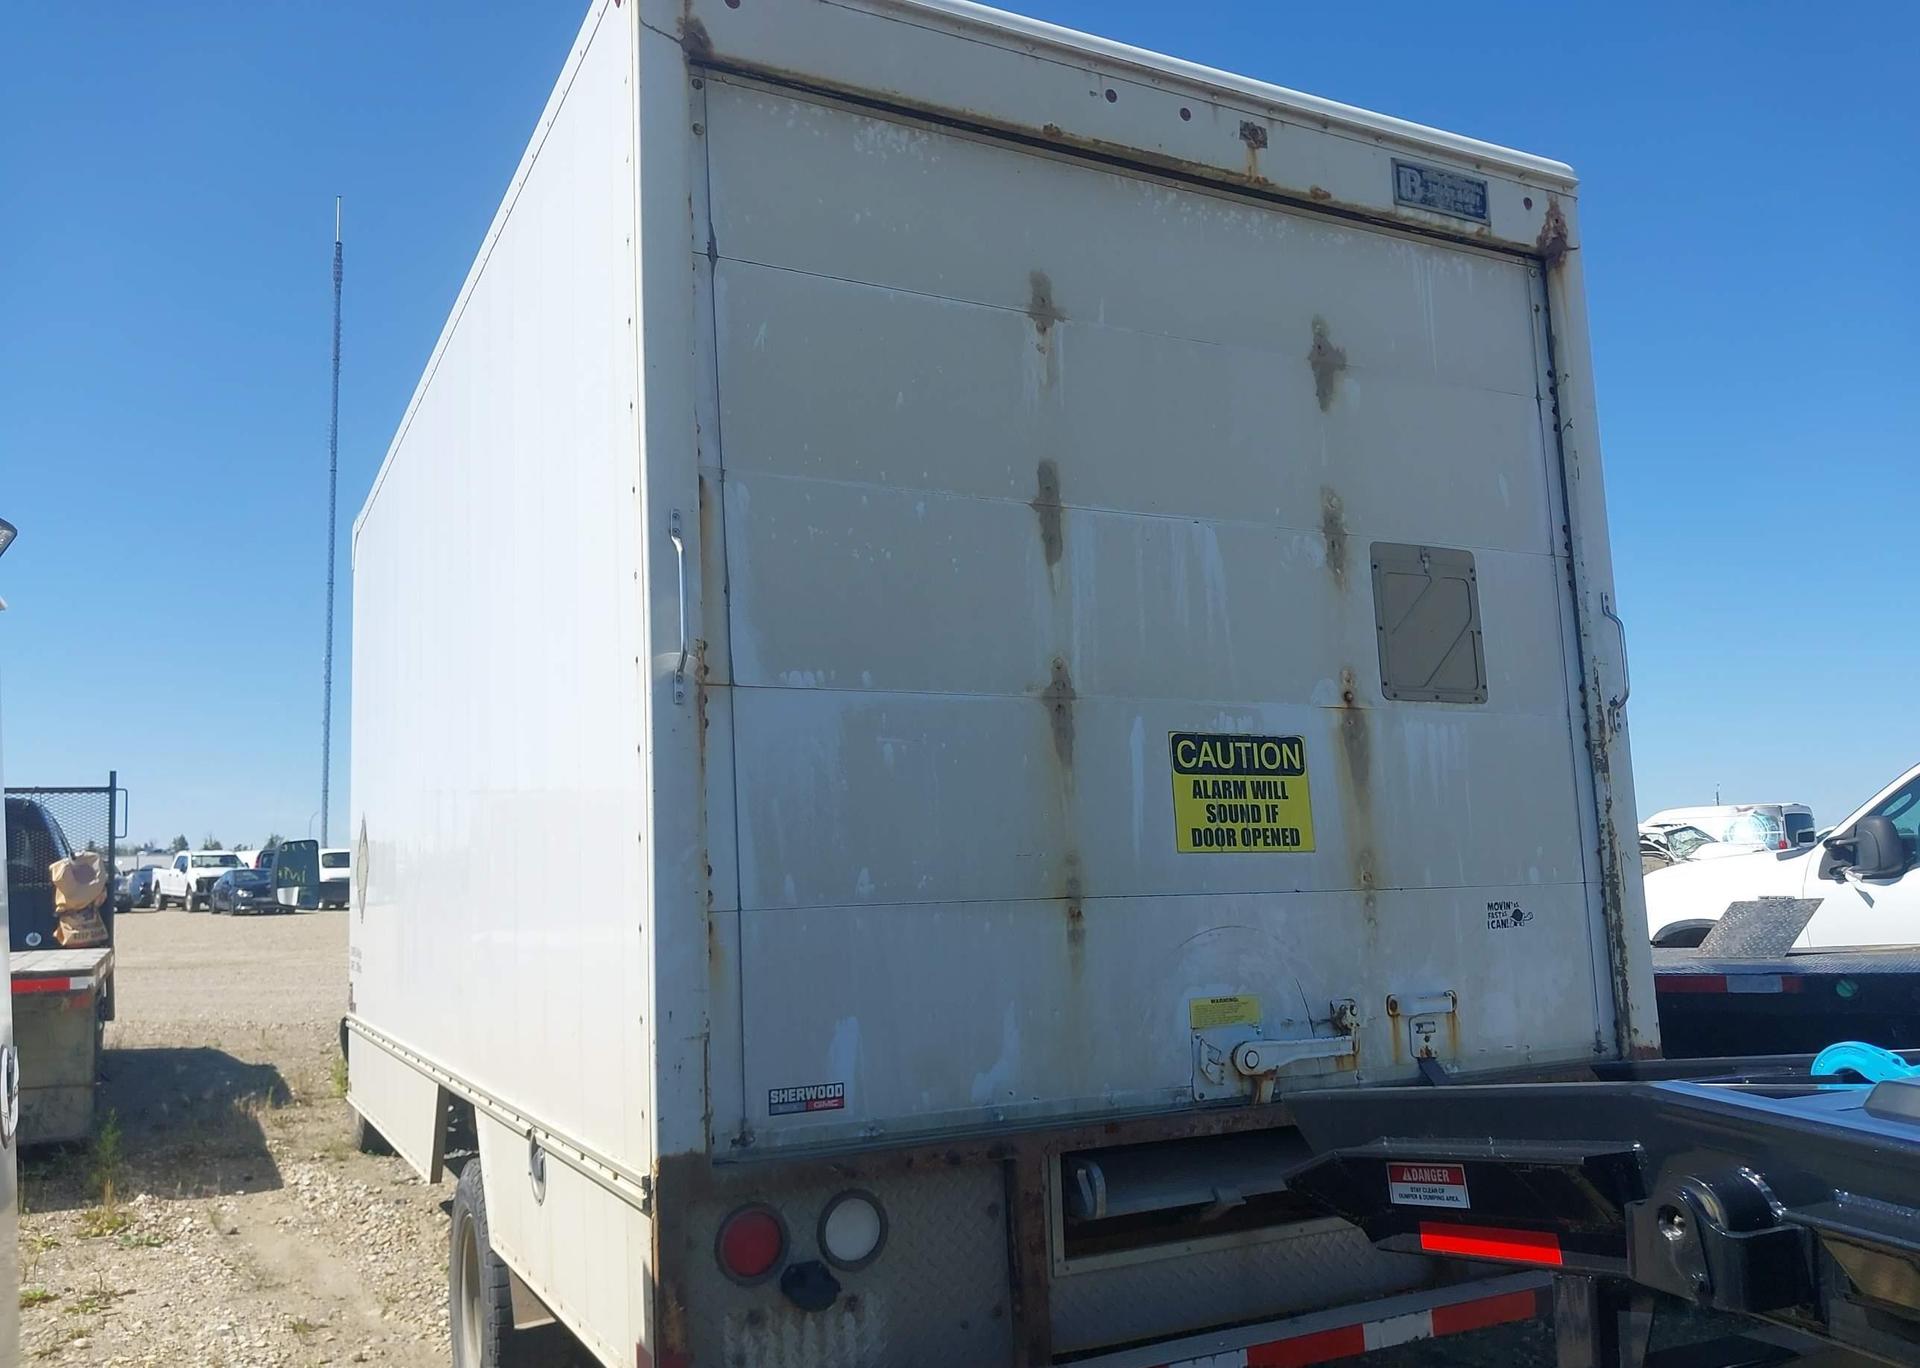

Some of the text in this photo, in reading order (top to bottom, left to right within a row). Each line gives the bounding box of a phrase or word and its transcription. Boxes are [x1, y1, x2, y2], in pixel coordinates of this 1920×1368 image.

[1177, 740, 1300, 769] CAUTION
[1192, 780, 1289, 799] ALARM WILL
[1205, 803, 1279, 824] SOUND IF
[1191, 827, 1301, 847] DOOR OPENED
[770, 1084, 843, 1104] SHERWOOD
[813, 1099, 839, 1109] GMC
[1411, 1168, 1450, 1183] DANGER
